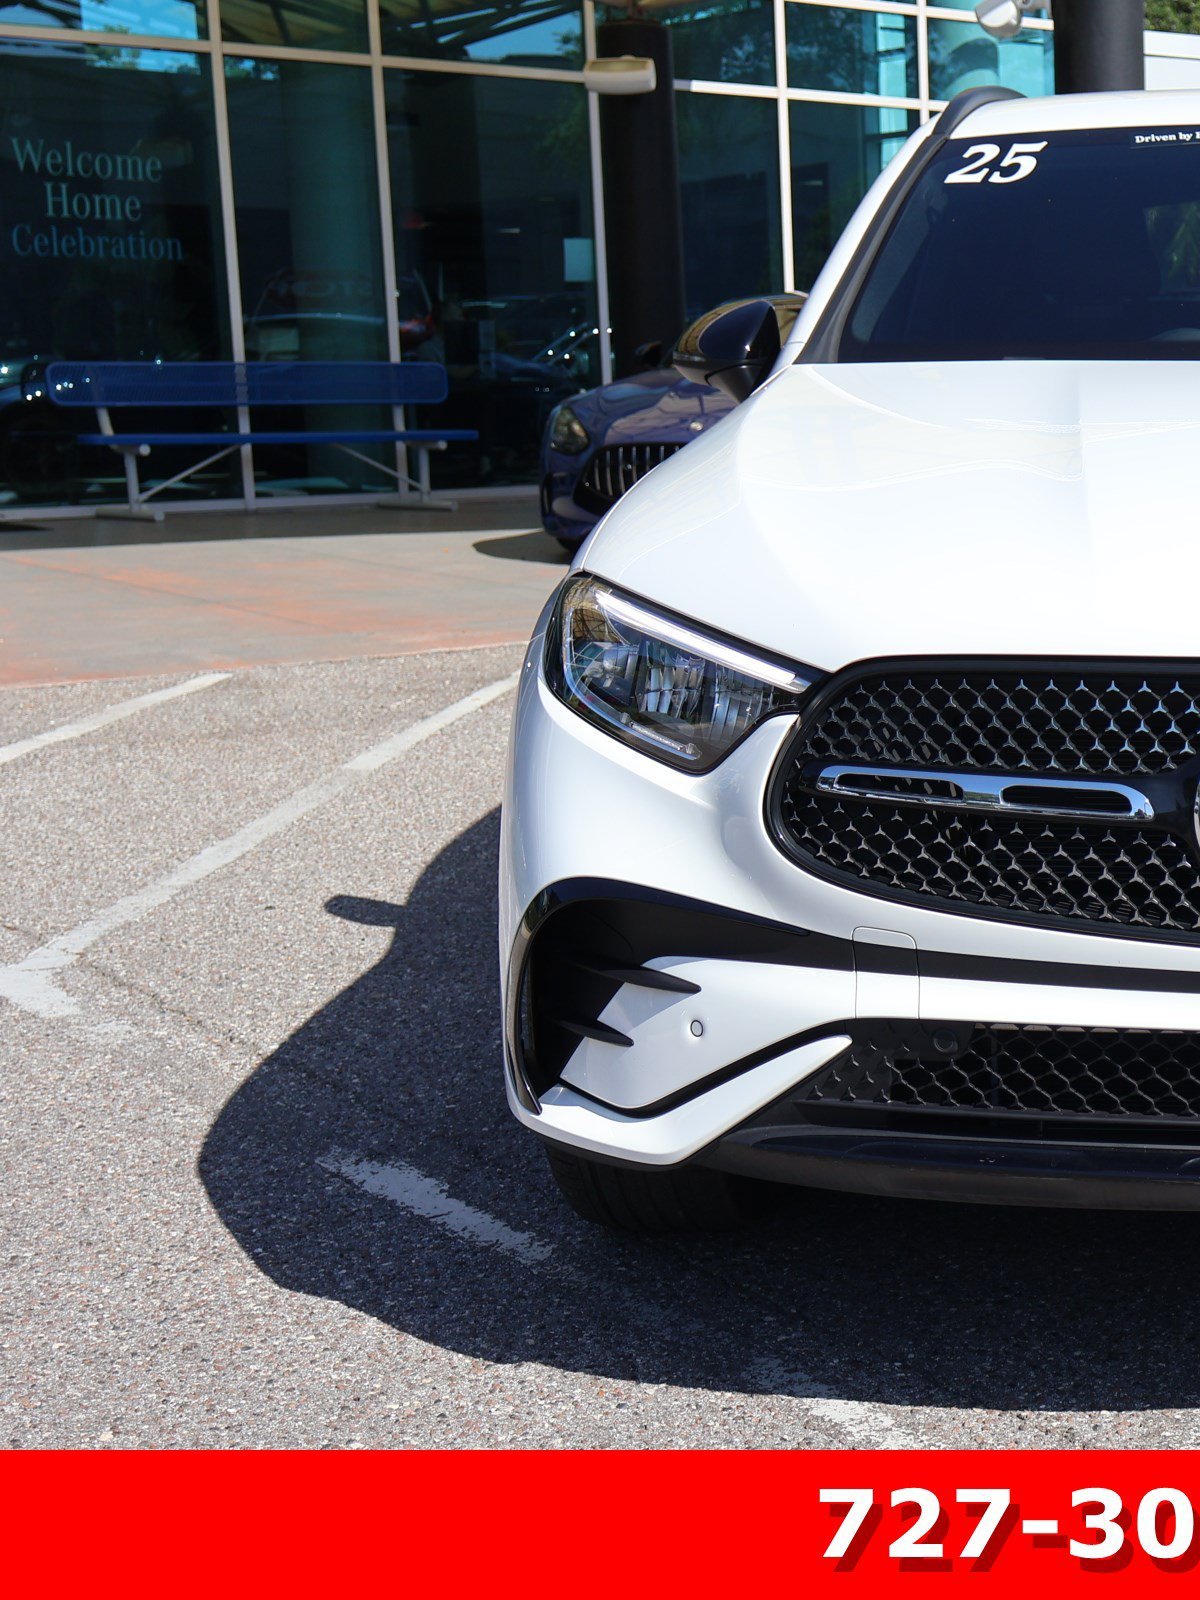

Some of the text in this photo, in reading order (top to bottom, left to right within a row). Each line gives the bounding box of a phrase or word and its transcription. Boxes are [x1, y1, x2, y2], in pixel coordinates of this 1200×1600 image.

[1135, 132, 1177, 144] Driven
[1178, 131, 1193, 142] by
[10, 136, 163, 182] Welcome
[943, 141, 1049, 184] 25
[44, 181, 142, 222] Home
[12, 223, 184, 261] Celebration
